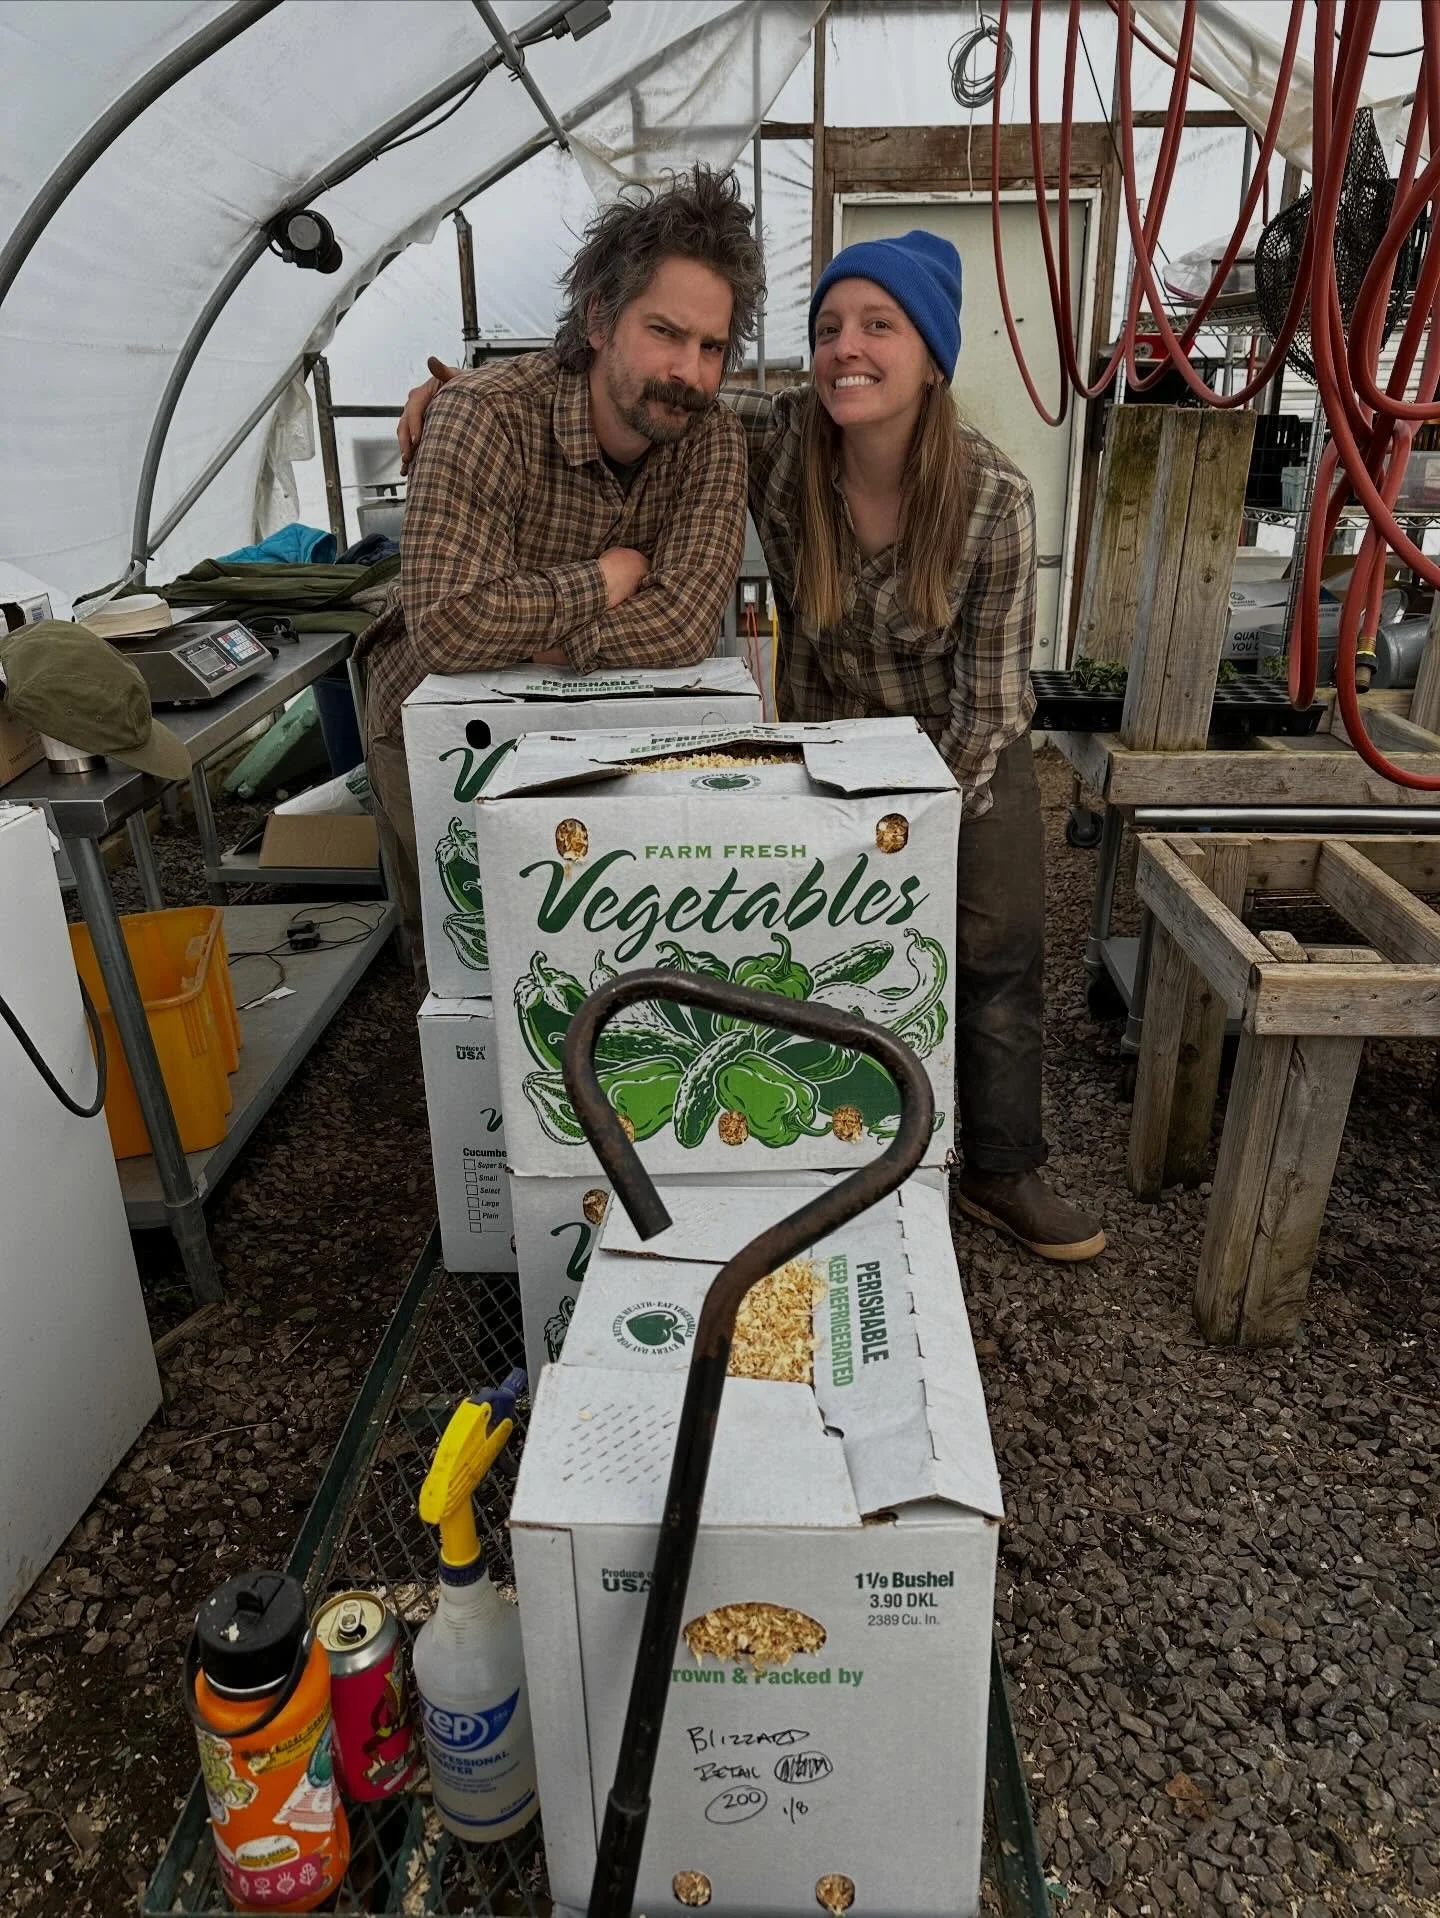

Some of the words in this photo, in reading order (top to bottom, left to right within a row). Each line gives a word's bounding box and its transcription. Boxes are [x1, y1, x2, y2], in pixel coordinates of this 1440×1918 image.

[1233, 631, 1259, 641] QUAL
[1231, 642, 1255, 651] YOU
[541, 679, 640, 689] PERISHABLE
[561, 684, 654, 694] REFRIGERATED
[651, 729, 776, 744] PERISHABLE
[629, 742, 672, 753] KEEP
[675, 734, 795, 749] REFRIGERATED
[645, 844, 713, 860] FARM
[723, 844, 807, 859] FRESH
[519, 849, 931, 964] Vegetables
[455, 1044, 480, 1052] Produce
[456, 1051, 486, 1061] USA
[462, 1147, 508, 1158] Cucumbe
[477, 1161, 497, 1170] Super
[478, 1174, 498, 1182] Small
[479, 1186, 501, 1194] Select
[481, 1200, 500, 1208] Large
[482, 1212, 499, 1220] Plain
[828, 1254, 848, 1284] KEEP
[622, 1301, 653, 1316] HEALTH
[657, 1301, 674, 1309] EAT
[856, 1260, 889, 1364] PERISHABLE
[829, 1286, 854, 1387] REFRIGERATED
[616, 1337, 633, 1349] FOR
[652, 1343, 680, 1355] EVERY
[601, 1568, 645, 1578] Produce
[892, 1571, 954, 1588] Bushel
[602, 1579, 653, 1593] USA
[870, 1593, 902, 1609] 3.90
[907, 1592, 938, 1607] DKL
[867, 1614, 900, 1626] 2389
[901, 1613, 922, 1626] Cu.
[924, 1613, 941, 1625] In.
[671, 1669, 725, 1684] rown
[732, 1667, 747, 1684] &
[754, 1667, 831, 1685] Packed
[838, 1667, 864, 1687] by
[722, 1790, 762, 1809] 200
